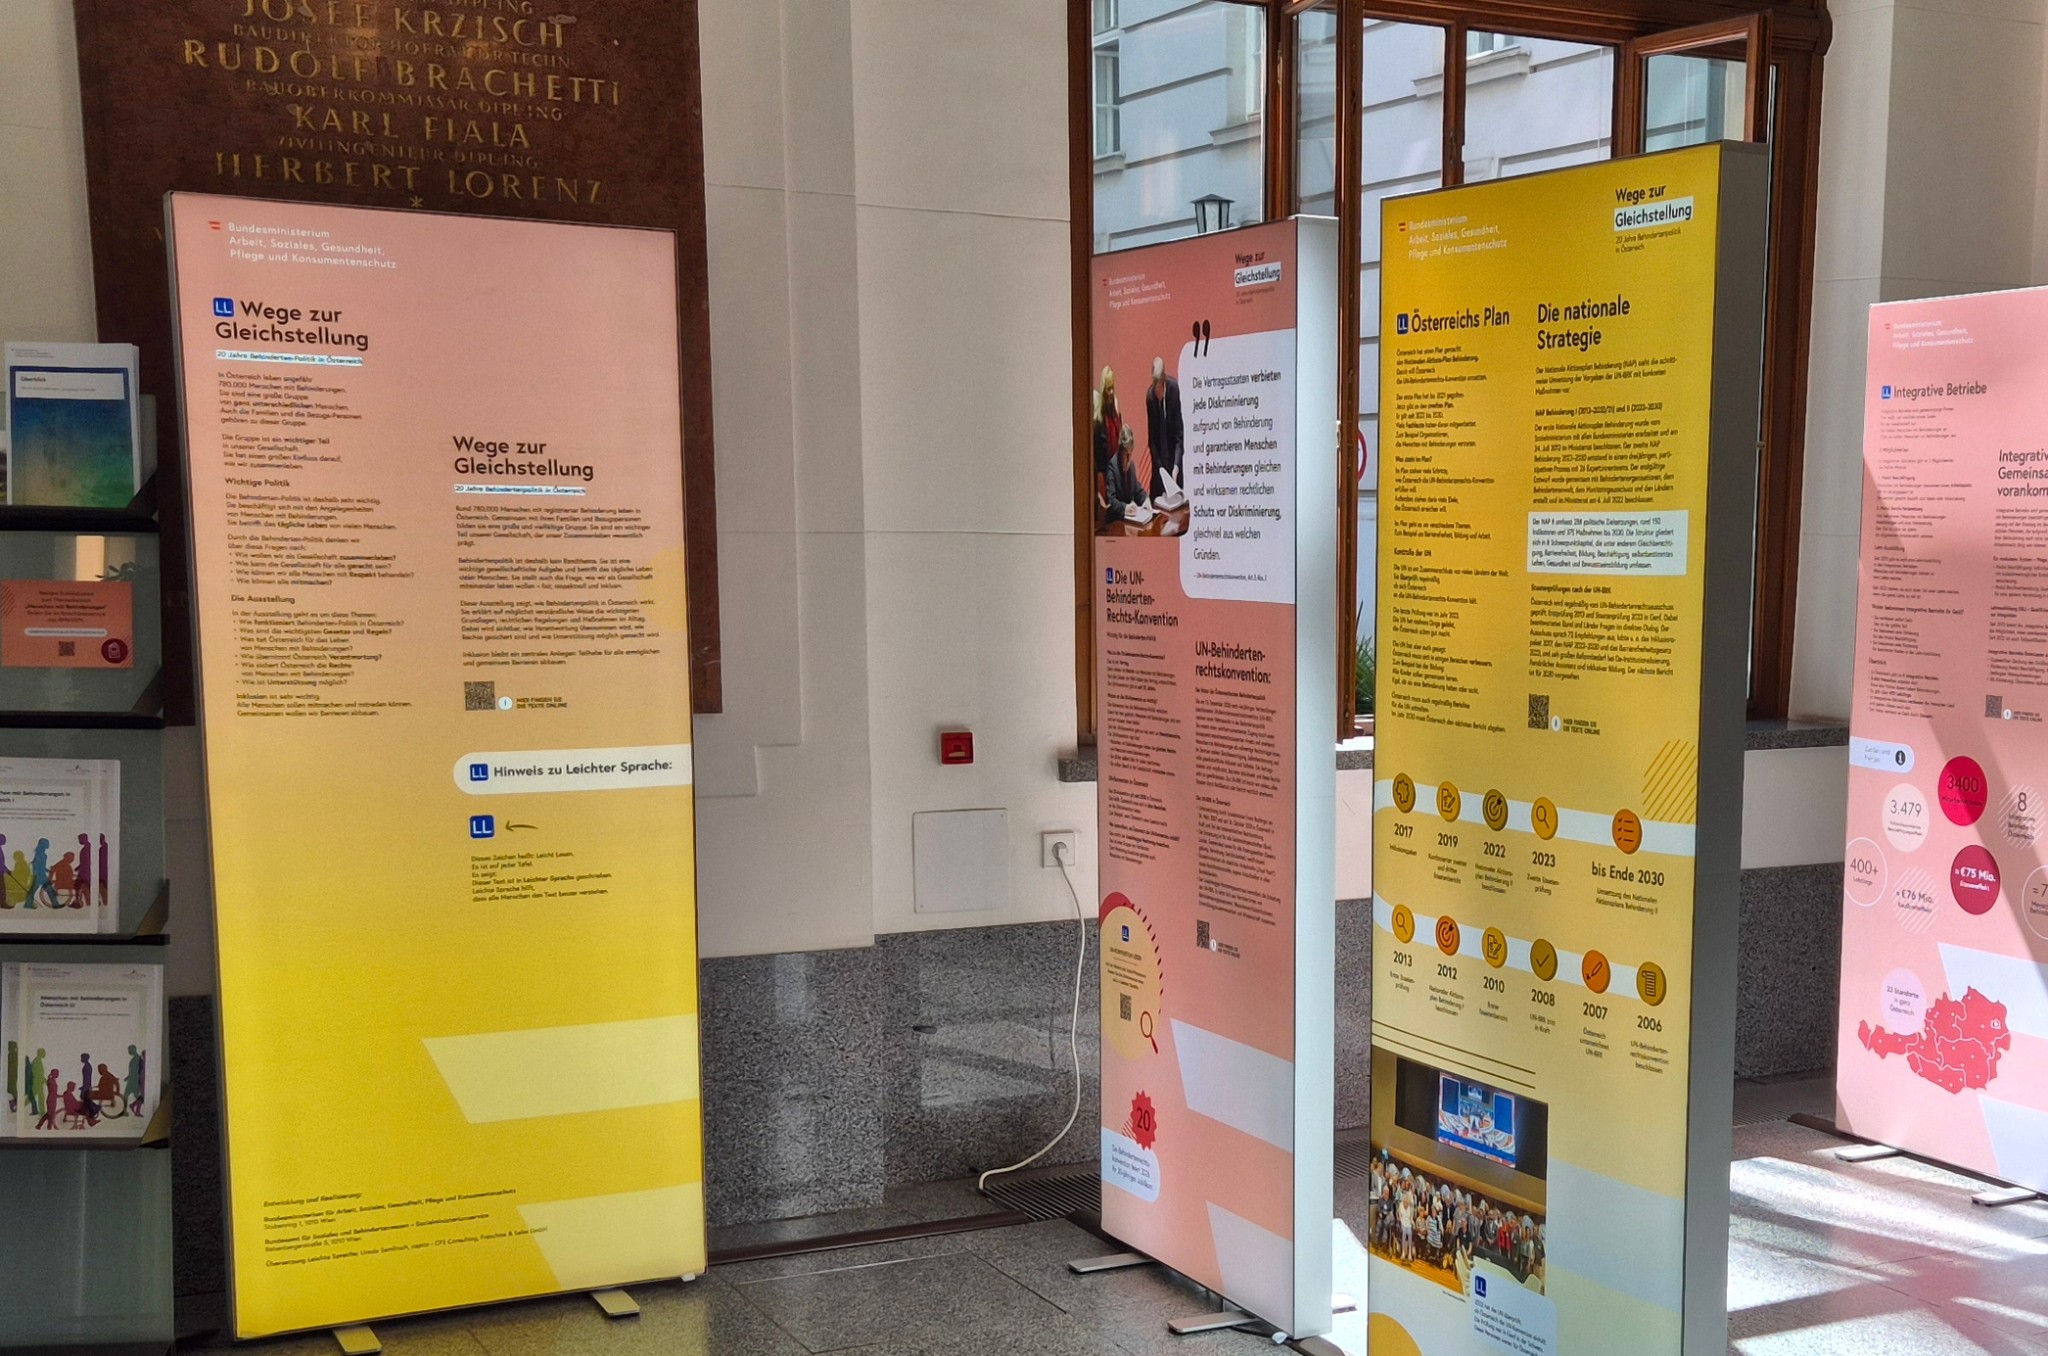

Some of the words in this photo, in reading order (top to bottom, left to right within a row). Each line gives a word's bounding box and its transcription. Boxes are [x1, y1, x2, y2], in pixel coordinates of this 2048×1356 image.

[394, 7, 563, 48] KRZISCH
[183, 38, 370, 82] RUDOLF
[396, 59, 620, 106] BRACHETTI
[294, 104, 399, 138] KARL
[424, 116, 531, 150] FIALA
[215, 152, 421, 191] HERBERT
[448, 169, 602, 206] LORENZ
[1615, 188, 1645, 205] Wege
[1649, 184, 1666, 198] zur
[1615, 203, 1692, 228] Gleichstellung
[228, 222, 330, 238] Bundesministerium
[229, 236, 266, 249] Arbeit,
[271, 238, 318, 252] Soziales,
[322, 242, 385, 256] Gesundheit,
[1408, 247, 1428, 260] Pflege
[1430, 245, 1441, 257] und
[230, 248, 265, 262] Pflege
[268, 252, 288, 262] und
[292, 254, 397, 269] Konsumentenschutz
[1235, 254, 1253, 267] Wege
[1255, 251, 1265, 261] zur
[1235, 267, 1281, 285] Gleichstellung
[215, 300, 233, 315] LL
[240, 300, 302, 325] Wege
[310, 308, 342, 323] zur
[1537, 303, 1560, 324] Die
[1563, 294, 1631, 321] nationale
[1411, 308, 1480, 333] Österreichs
[1483, 305, 1510, 326] Plan
[215, 322, 370, 352] Gleichstellung
[1537, 325, 1602, 352] Strategie
[1192, 376, 1202, 389] Die
[1203, 374, 1249, 390] Vertragsstaaten
[1250, 370, 1281, 383] verbieten
[1893, 383, 1944, 400] Integrative
[1946, 380, 1987, 396] Betriebe
[1192, 399, 1207, 413] jede
[1208, 395, 1259, 410] Diskriminierung
[1192, 418, 1220, 433] aufgrund
[1221, 420, 1232, 430] von
[1233, 415, 1273, 431] Behinderung
[452, 436, 510, 458] Wege
[516, 441, 547, 455] zur
[1193, 442, 1204, 454] und
[1205, 440, 1242, 456] garantieren
[1244, 437, 1278, 450] Menschen
[454, 458, 594, 481] Gleichstellung
[1193, 464, 1204, 475] mit
[1205, 463, 1253, 477] Behinderungen
[1254, 461, 1281, 476] gleichen
[225, 477, 262, 487] Wichtige
[264, 479, 290, 488] Politik
[1193, 485, 1204, 496] und
[1205, 485, 1238, 496] wirksamen
[1239, 484, 1274, 496] rechtlichen
[1193, 506, 1215, 518] Schutz
[1216, 508, 1226, 517] vor
[1228, 506, 1282, 521] Diskriminierung,
[1193, 528, 1222, 541] gleichviel
[1223, 530, 1234, 539] aus
[1235, 528, 1261, 539] welchen
[1193, 548, 1221, 561] Gründen.
[1114, 570, 1128, 584] Die
[1130, 571, 1145, 586] UN-
[231, 594, 245, 603] Die
[247, 595, 295, 604] Ausstellung
[1106, 588, 1155, 605] Behinderten-
[1106, 608, 1178, 627] Rechts-Konvention
[1195, 641, 1266, 662] UN-Behinderten-
[1195, 662, 1271, 684] rechtskonvention:
[471, 766, 487, 780] LL
[494, 765, 543, 778] Hinweis
[548, 767, 562, 776] zu
[566, 763, 616, 776] Leichter
[620, 760, 673, 775] Sprache:
[1946, 775, 1979, 793] 3400
[1890, 799, 1922, 817] 3.479
[2017, 792, 2027, 812] 8
[471, 818, 493, 836] LL
[1394, 823, 1413, 839] 2017
[1437, 832, 1459, 848] 2019
[1483, 842, 1506, 859] 2022
[1532, 851, 1556, 868] 2023
[1591, 861, 1607, 878] bis
[1609, 864, 1635, 882] Ende
[1638, 868, 1665, 886] 2030
[1850, 857, 1879, 876] 400+
[1960, 867, 1977, 879] €75
[1978, 869, 1996, 882] Mio.
[1393, 951, 1413, 967] 2013
[1437, 963, 1458, 980] 2012
[1483, 976, 1505, 994] 2010
[1531, 988, 1556, 1007] 2008
[1582, 1002, 1608, 1020] 2007
[1636, 1015, 1663, 1032] 2006
[1136, 1106, 1151, 1131] 20
